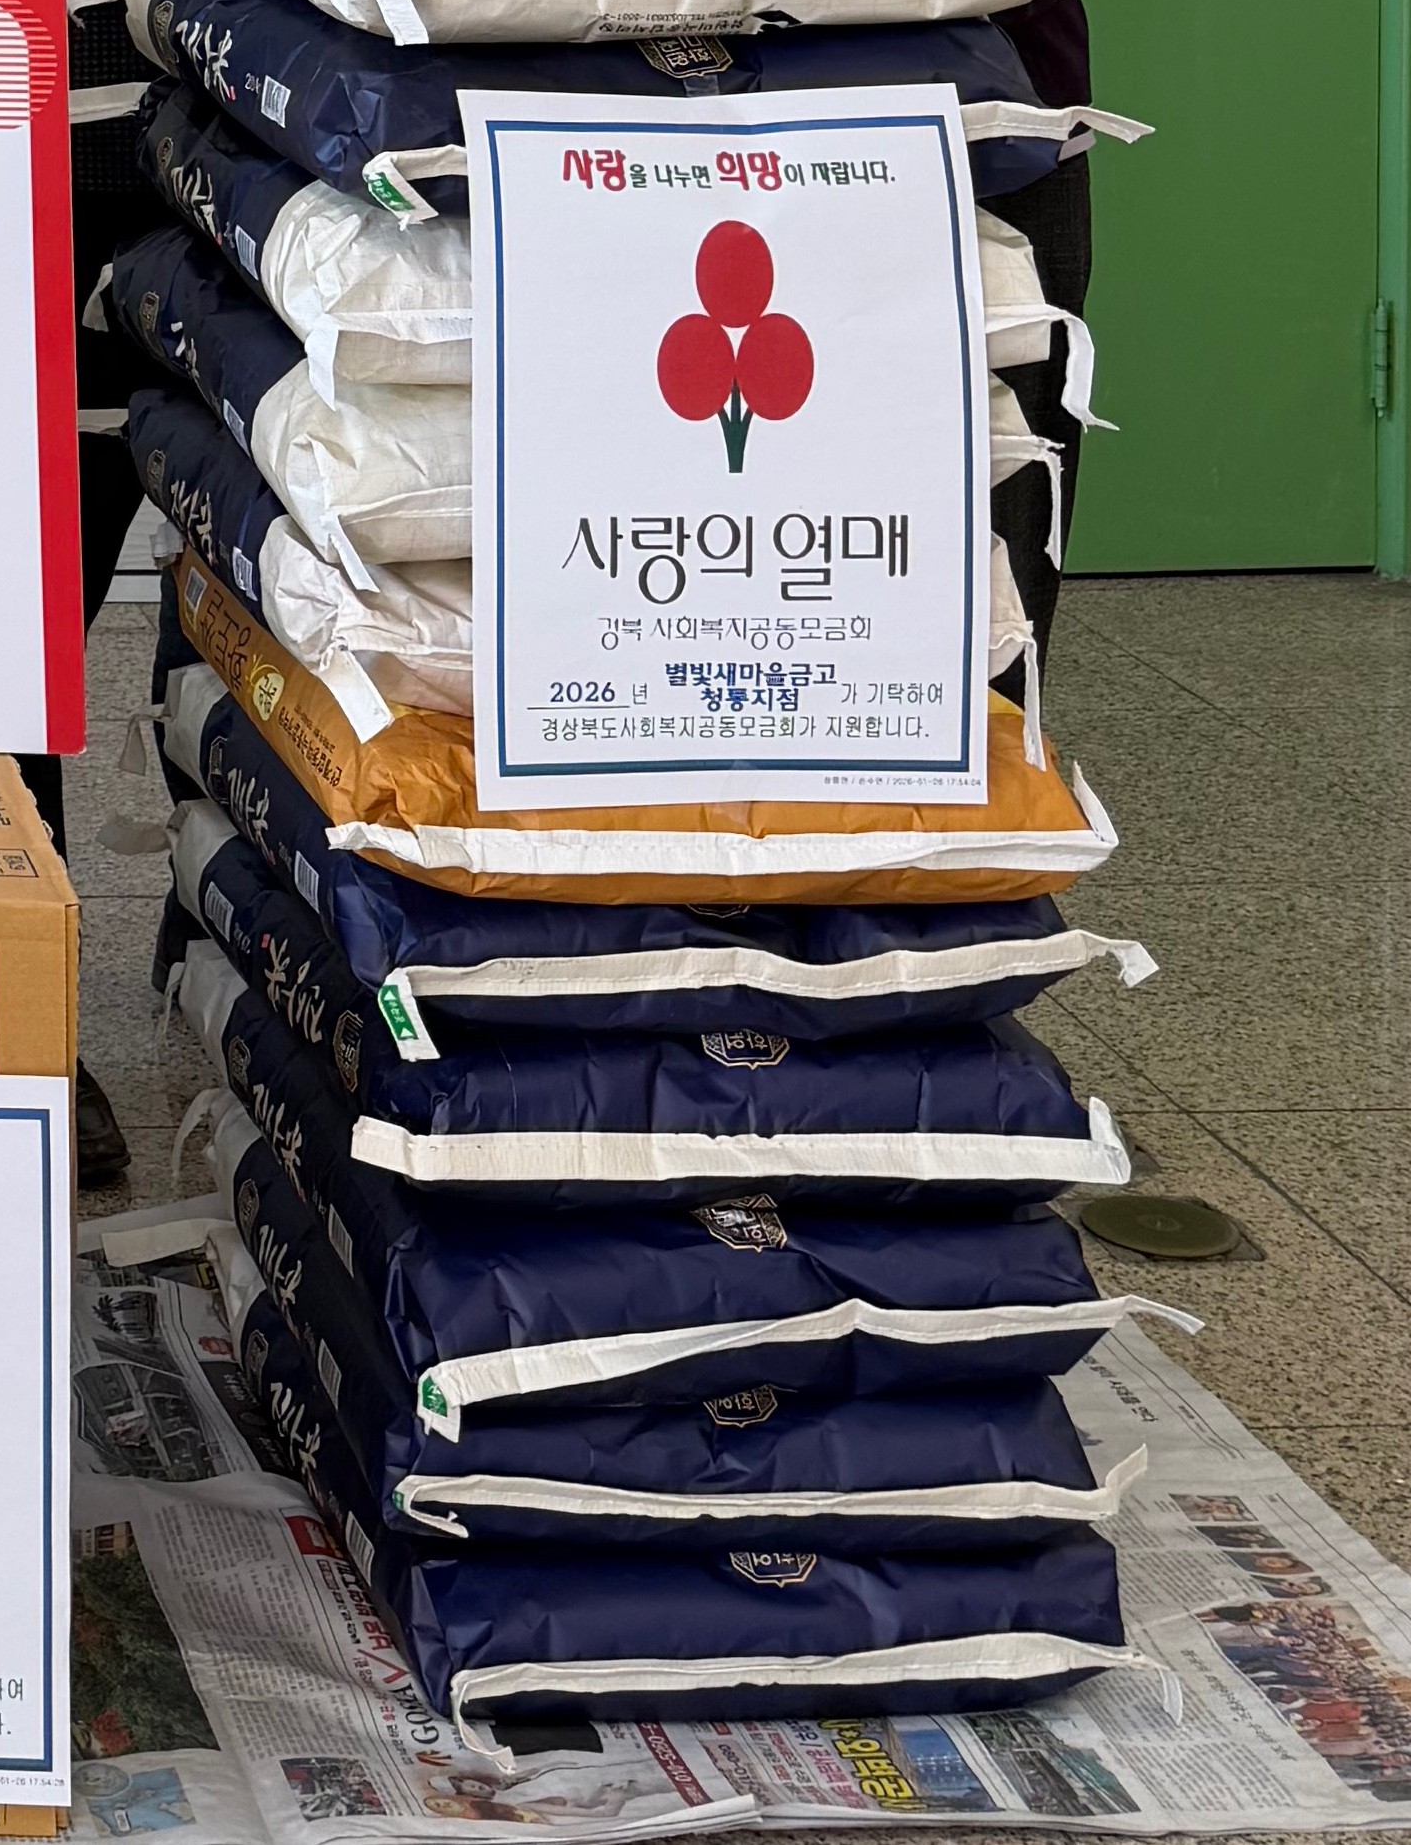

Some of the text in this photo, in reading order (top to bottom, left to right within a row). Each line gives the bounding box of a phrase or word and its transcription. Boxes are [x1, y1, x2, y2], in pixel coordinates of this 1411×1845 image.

[562, 149, 896, 192] 사랑을 나누면 희망이 자랍니다.
[561, 513, 909, 605] 사랑의 열매
[598, 614, 871, 651] 경북 사회복지공동모금회
[549, 662, 943, 712] 2026 년 별빛새마을금고 청통지점 가 기탁하여
[541, 715, 930, 742] 경상북도사회복지공동모금회가 지원합니다.
